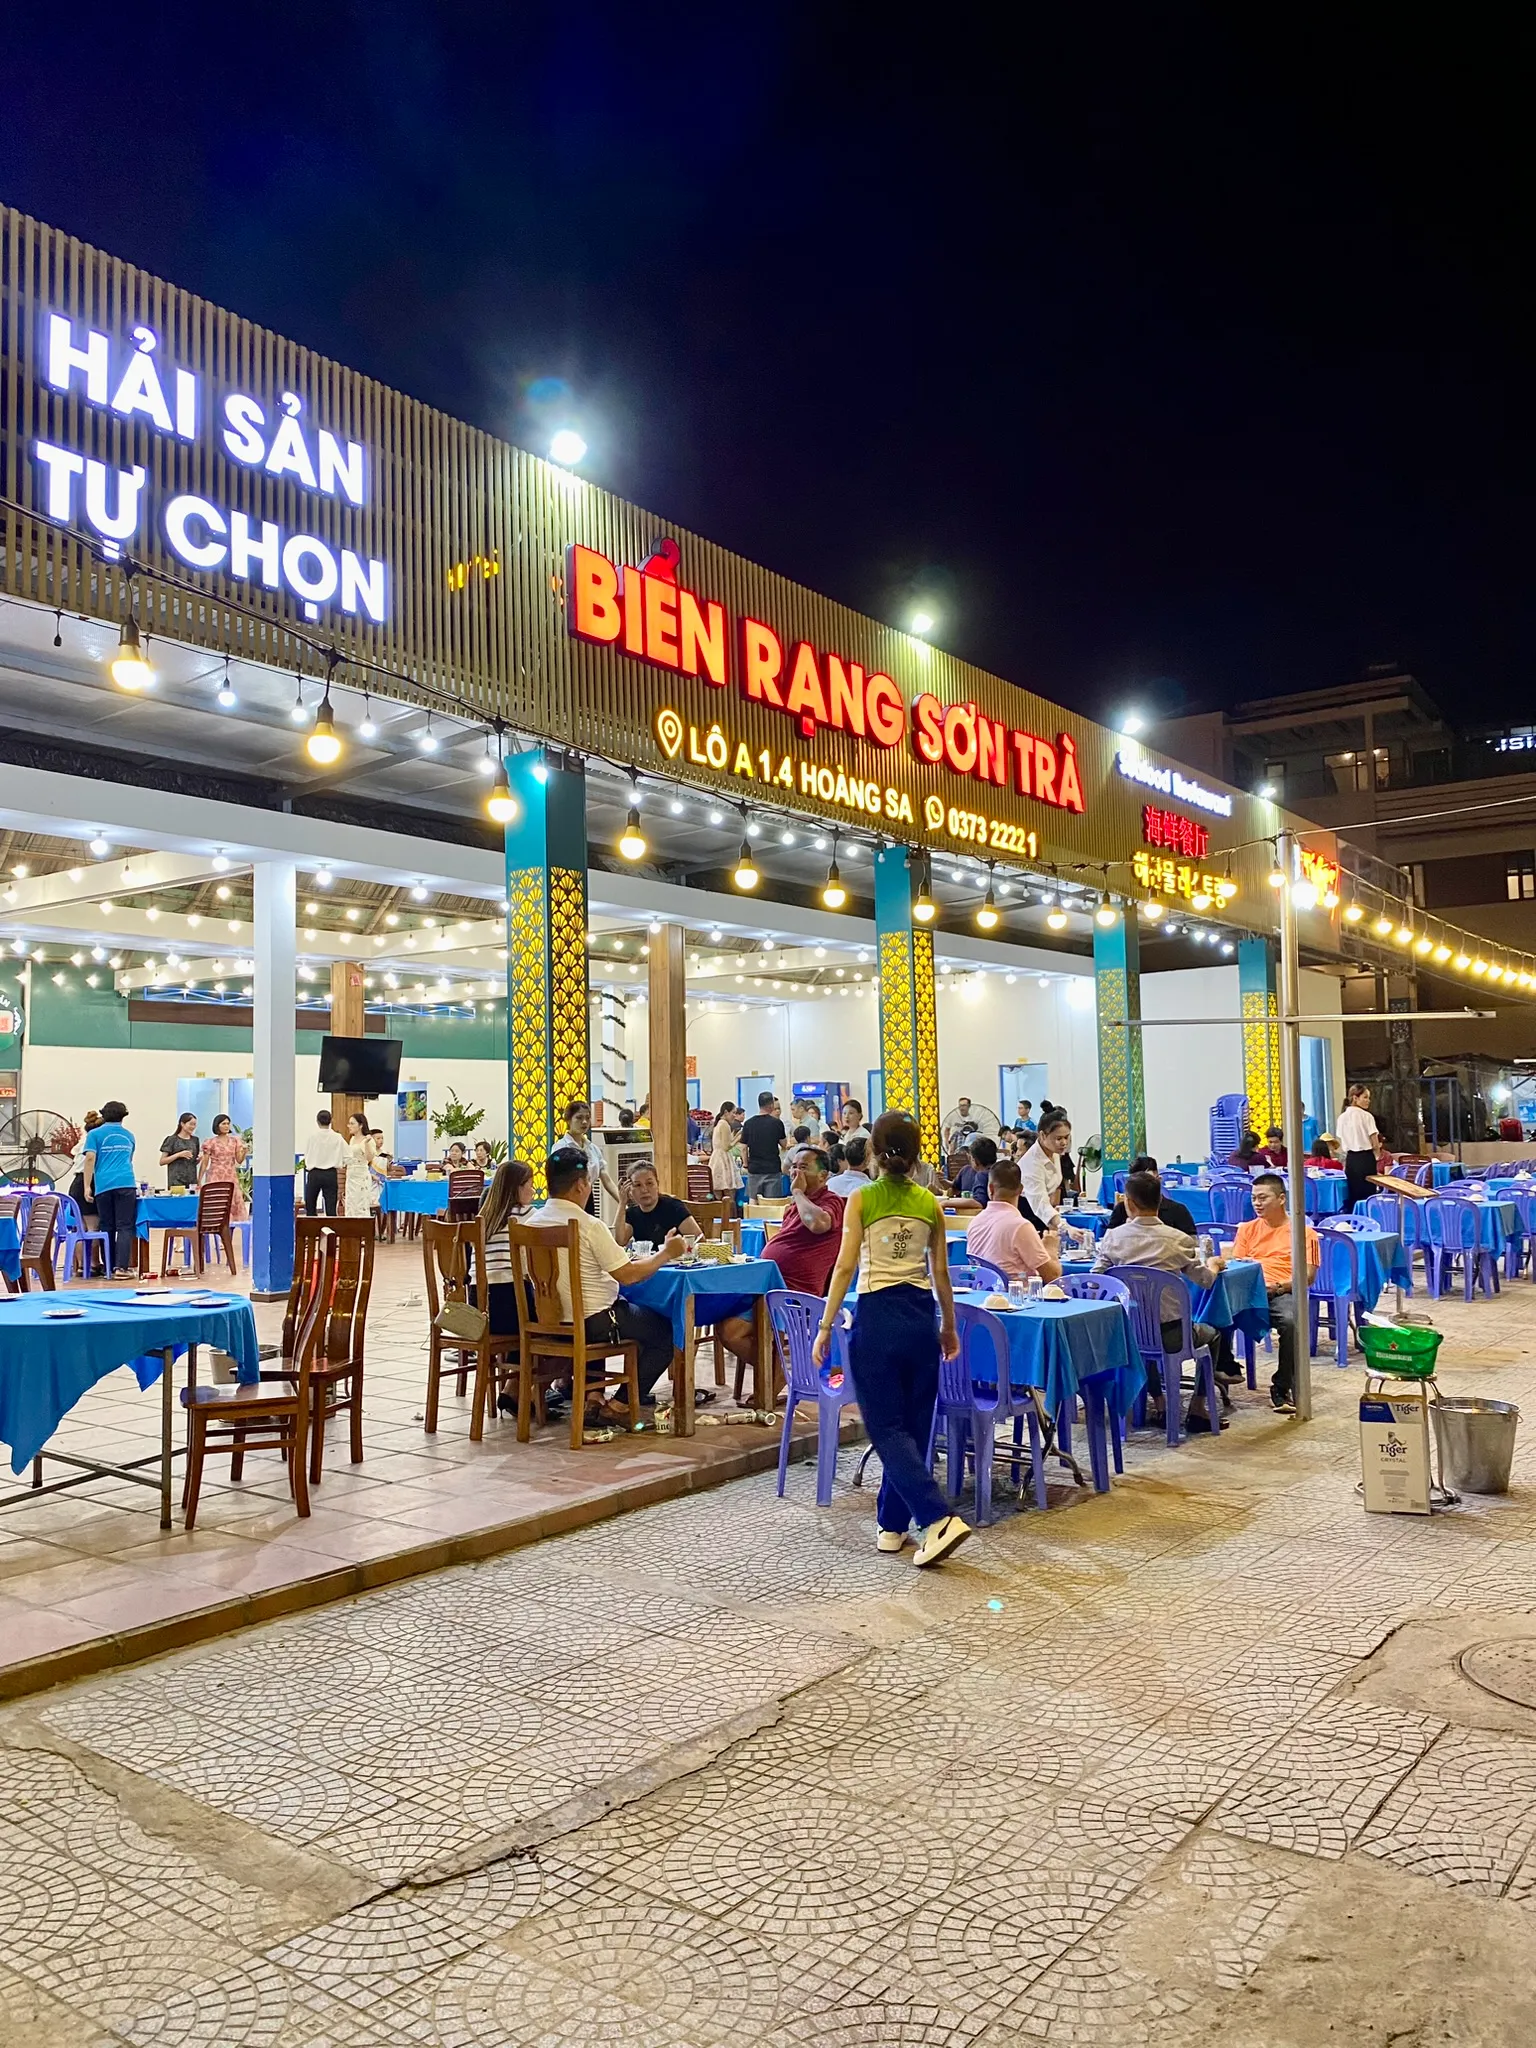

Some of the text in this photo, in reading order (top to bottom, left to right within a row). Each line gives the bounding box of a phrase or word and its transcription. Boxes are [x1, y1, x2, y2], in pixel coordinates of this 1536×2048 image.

[48, 312, 363, 506] HẢI SẢN
[36, 440, 384, 623] TỰ CHỌN
[568, 537, 1085, 813] BIỂN RẠNG SƠN TRÀ
[689, 723, 728, 768] LÔ
[732, 742, 754, 778] A
[800, 760, 882, 814] HOÀNG
[885, 787, 914, 823] SA
[948, 807, 987, 843] 0373
[1145, 805, 1210, 859] 海鲜餐厅
[891, 1231, 914, 1242] Tiger
[1395, 1403, 1420, 1415] Tiger
[1378, 1443, 1408, 1458] Tiger
[1380, 1456, 1407, 1464] CRYSTAL
